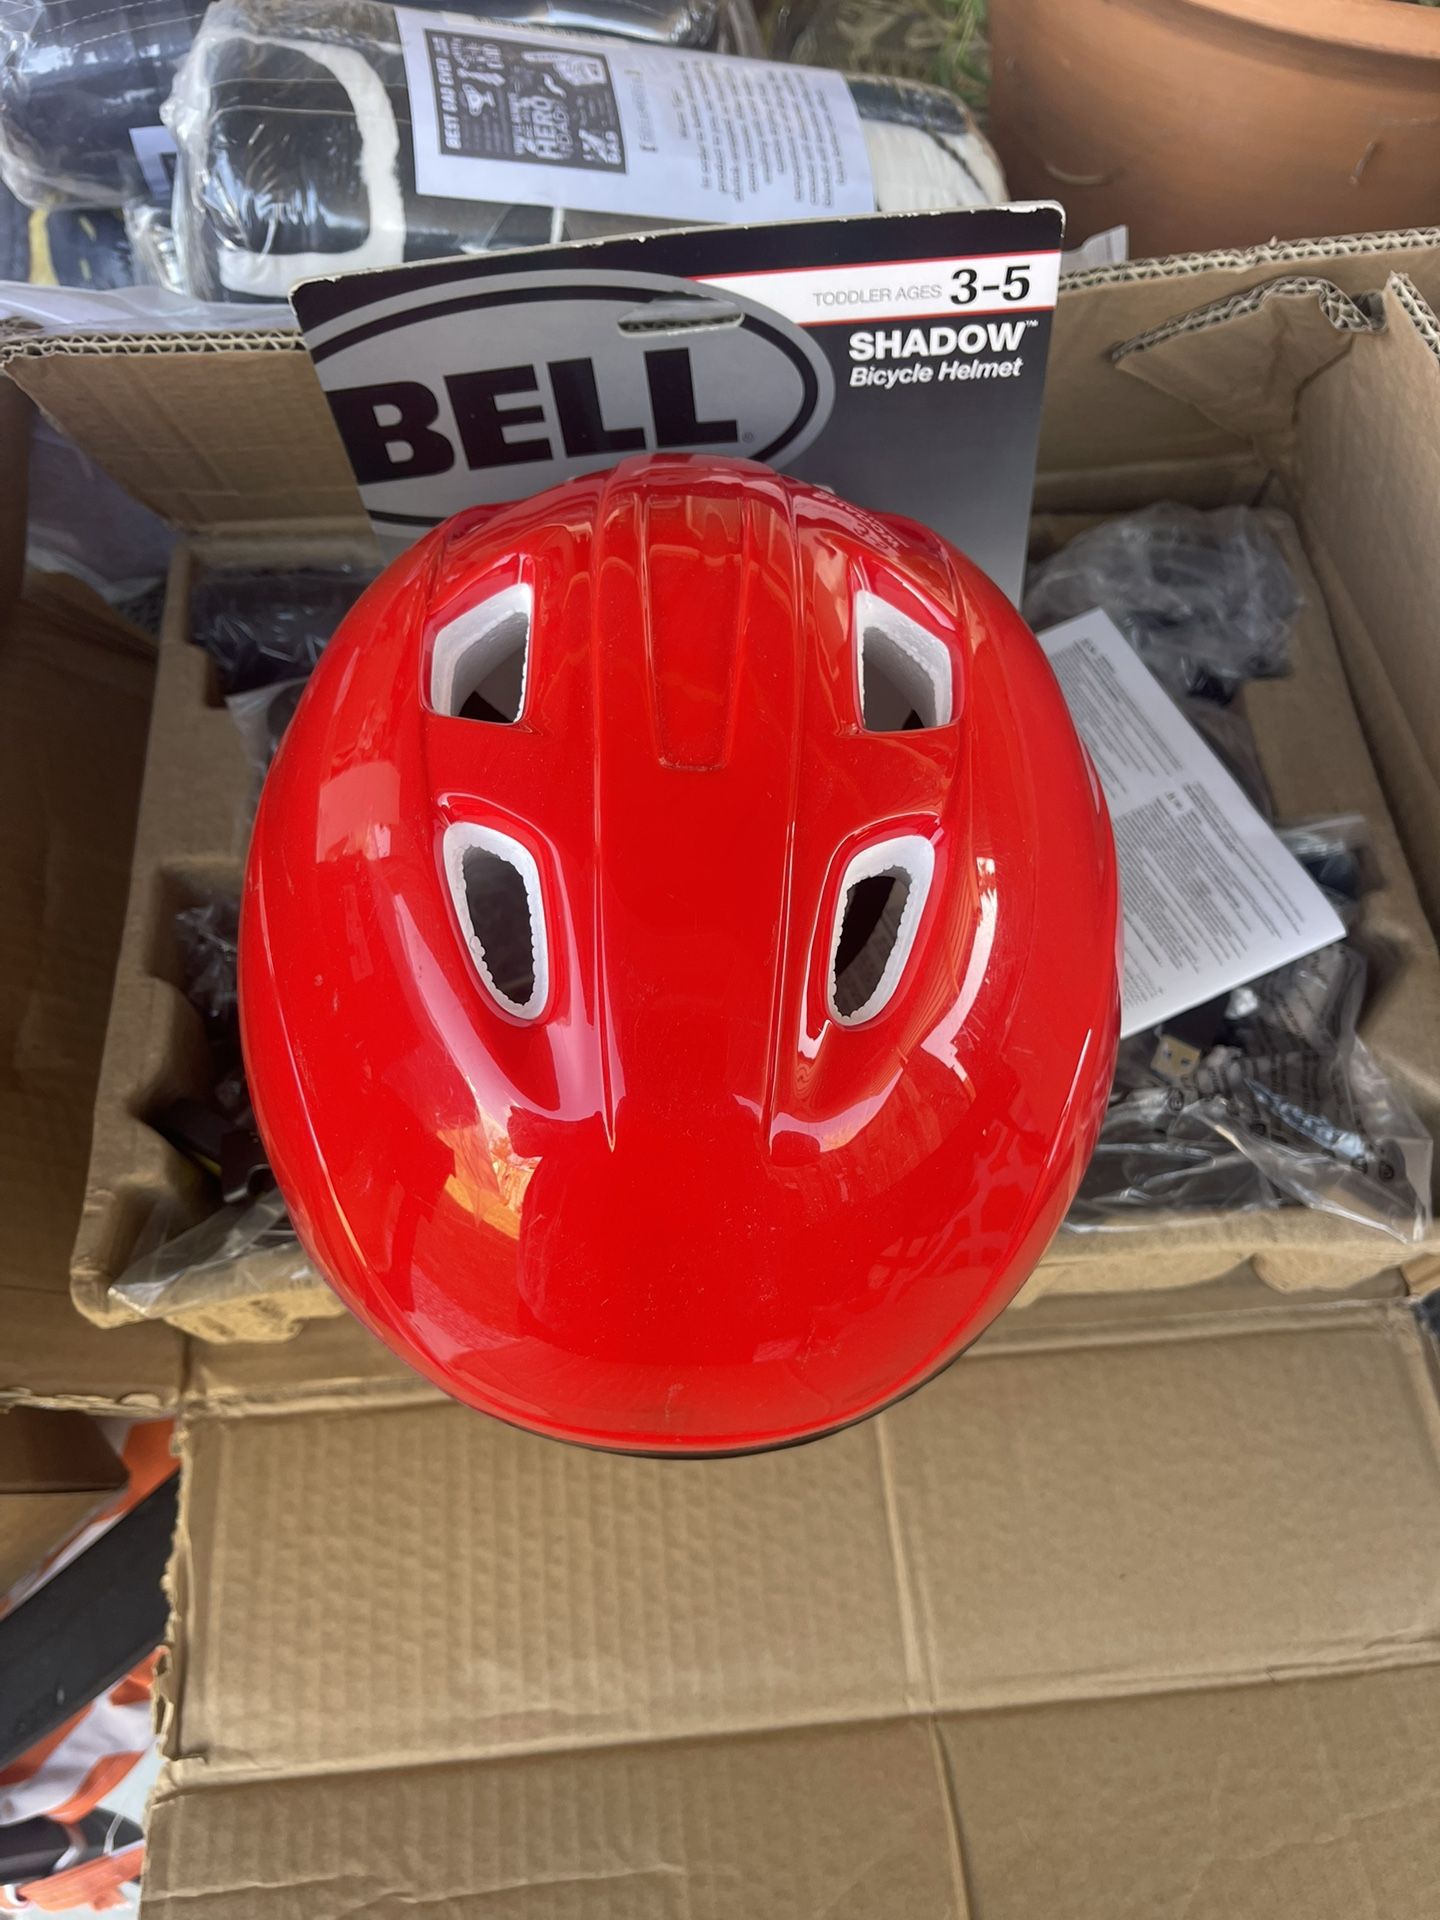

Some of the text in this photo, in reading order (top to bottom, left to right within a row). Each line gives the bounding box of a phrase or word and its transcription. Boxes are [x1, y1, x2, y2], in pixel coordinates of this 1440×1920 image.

[813, 264, 1031, 307] TODDLER AGES 3-5
[849, 357, 1024, 390] Bicycle Helmet
